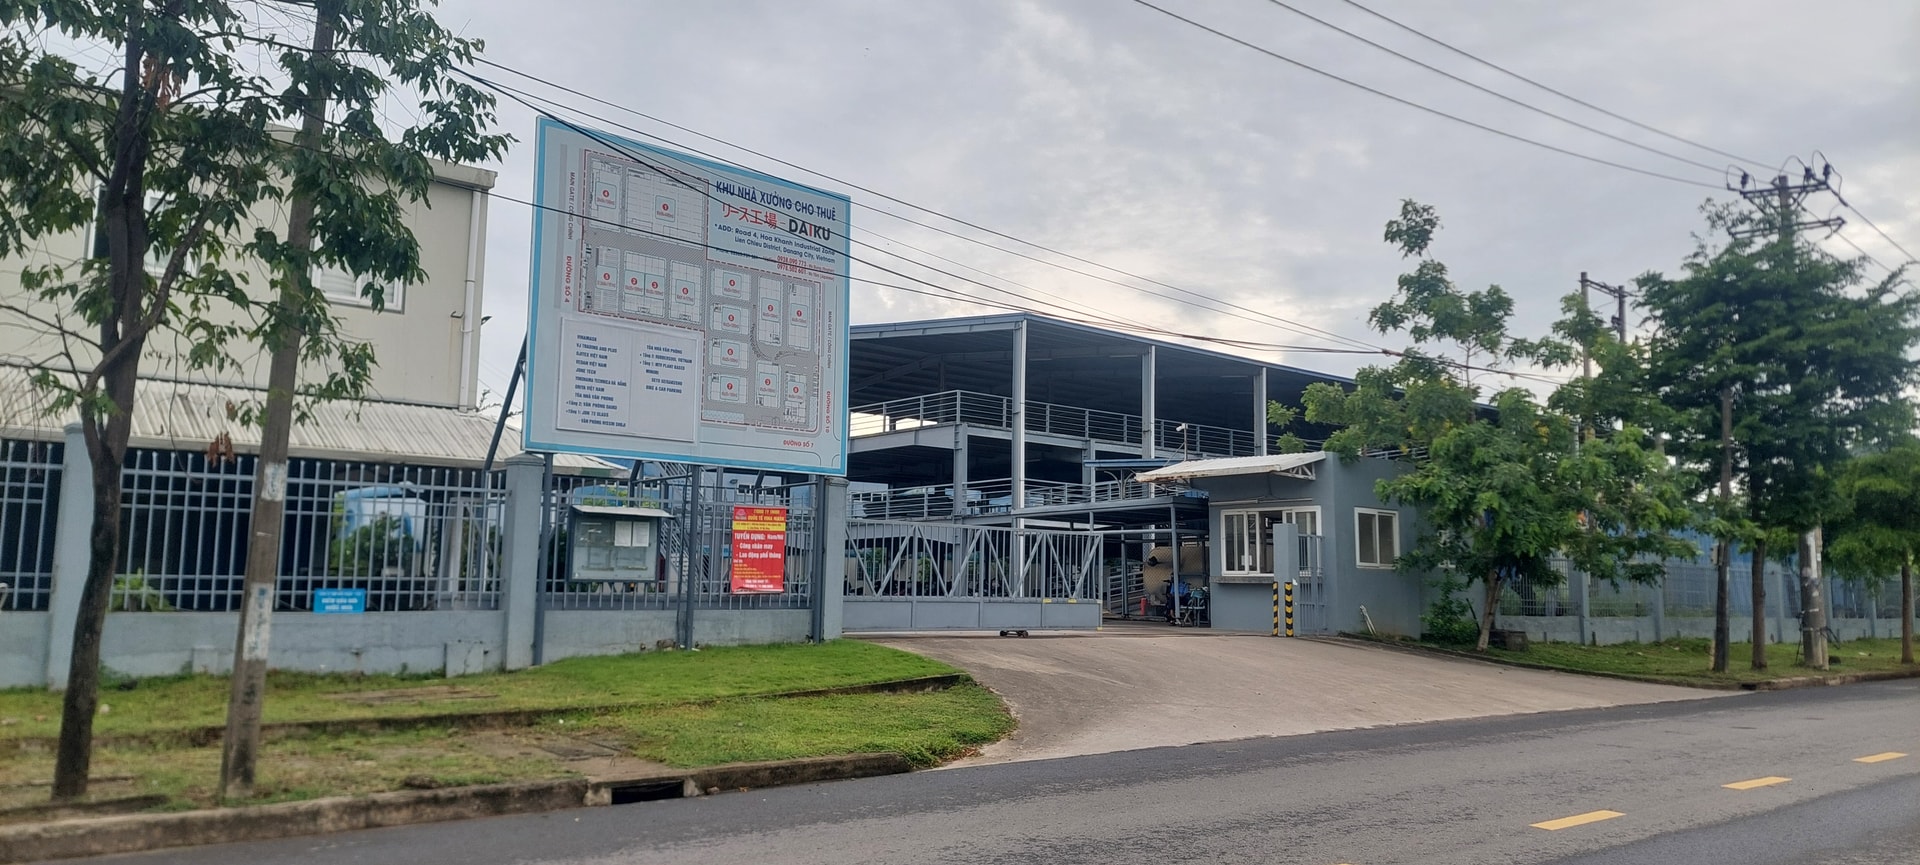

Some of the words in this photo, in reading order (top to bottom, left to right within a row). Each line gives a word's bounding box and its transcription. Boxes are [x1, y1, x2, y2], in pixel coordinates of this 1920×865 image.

[716, 181, 734, 196] KHU
[738, 187, 757, 201] NHÀ
[760, 191, 792, 210] XƯỞNG
[795, 201, 814, 215] CHO
[817, 206, 836, 220] THUÊ
[722, 203, 777, 230] リース工場
[735, 228, 751, 236] Road
[774, 236, 792, 246] Khanh
[795, 240, 820, 252] Industrial
[822, 247, 835, 256] Zone
[789, 219, 830, 240] DAIKU
[763, 241, 782, 253] District,
[783, 247, 802, 259] Danang
[804, 250, 814, 260] City,
[816, 253, 835, 264] Vietnam
[735, 531, 750, 540] TUYỂN
